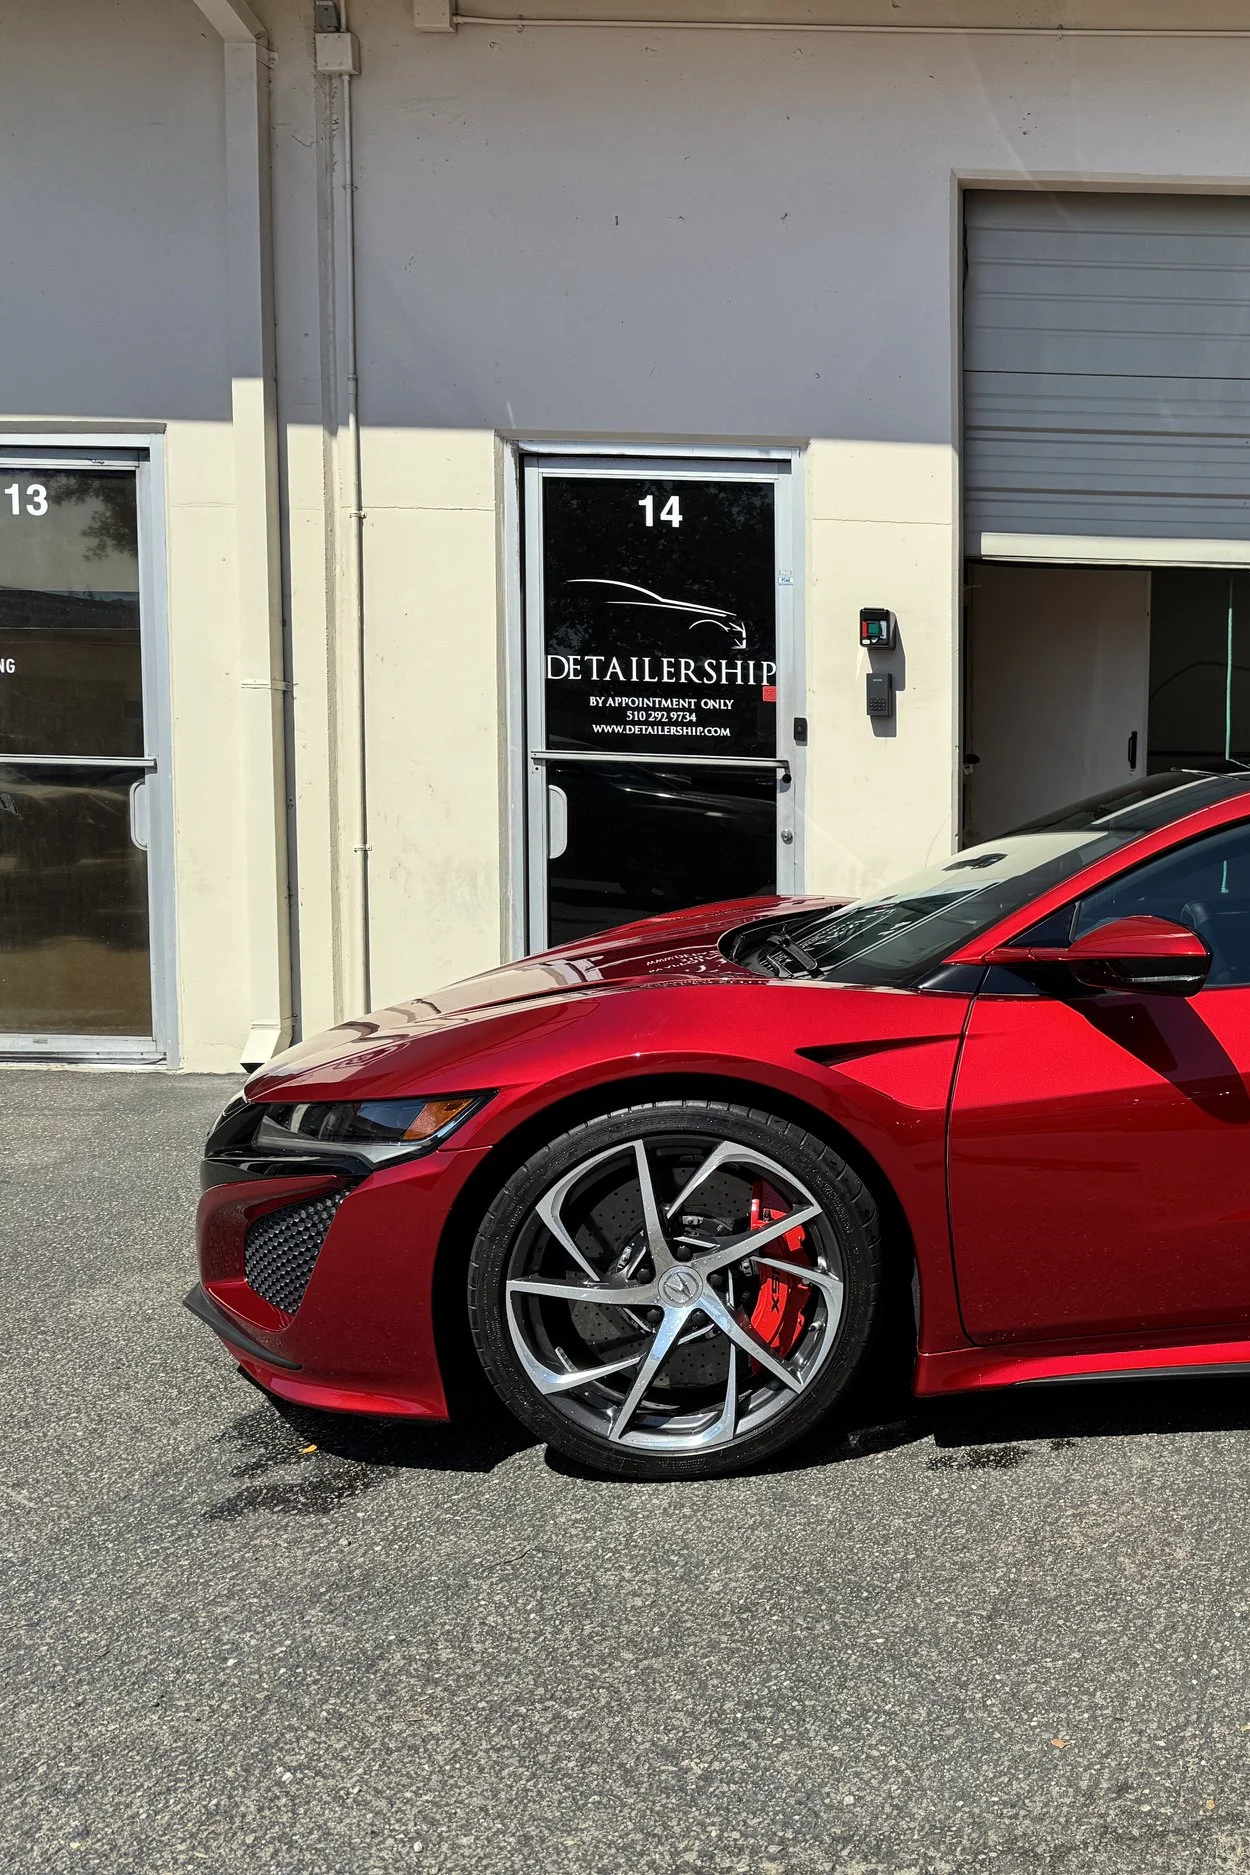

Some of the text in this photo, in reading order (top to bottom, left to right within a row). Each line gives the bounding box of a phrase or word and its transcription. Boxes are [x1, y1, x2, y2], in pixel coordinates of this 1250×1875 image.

[4, 483, 49, 517] 13
[638, 494, 683, 528] 14
[546, 654, 777, 687] DETAILERSHIP
[589, 696, 734, 710] BY APPOINTMENT ONLY
[626, 710, 697, 723] 510 292 9734
[592, 724, 731, 737] WWW.DETAILERSHIP.COM
